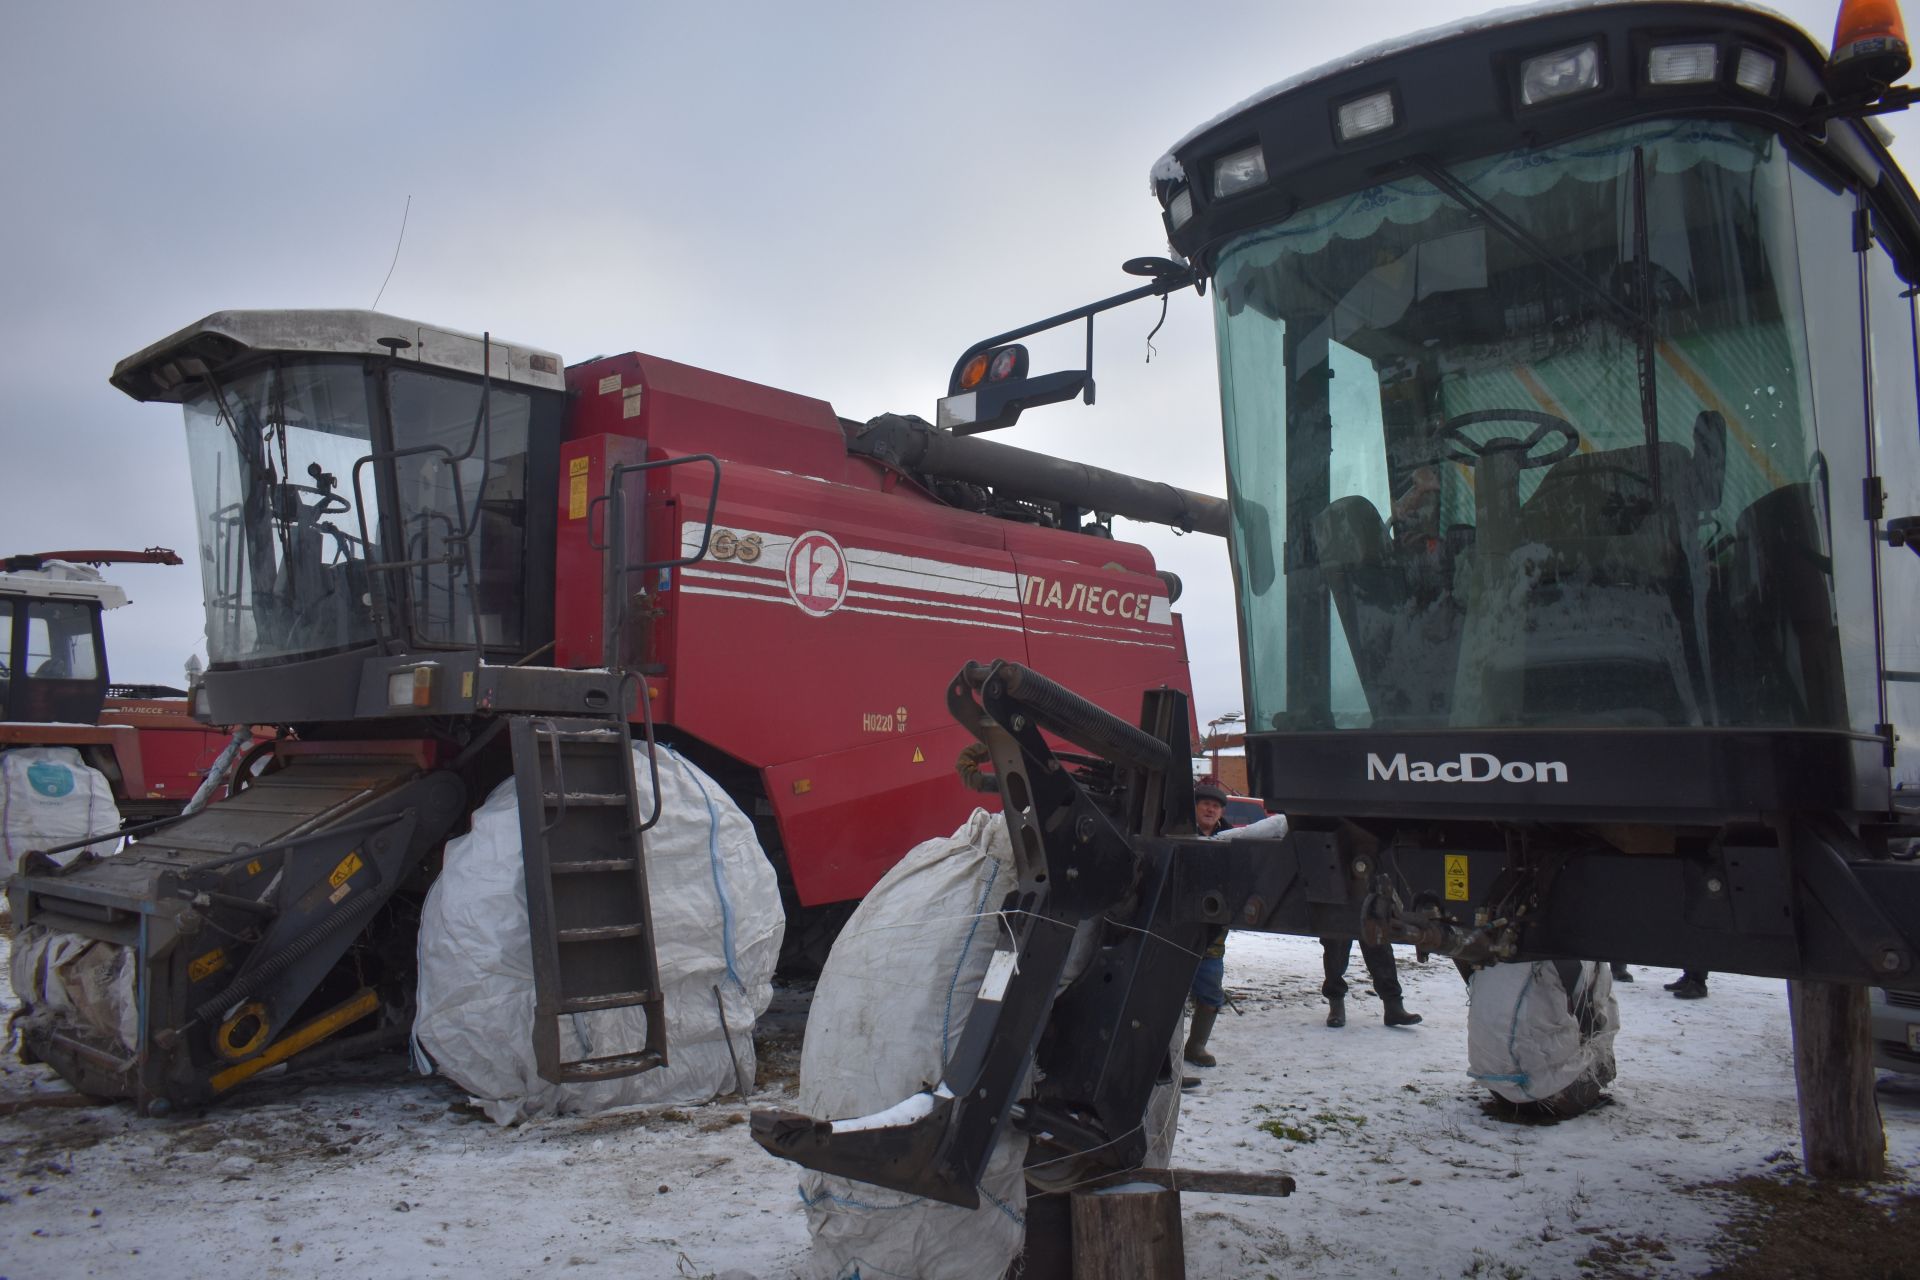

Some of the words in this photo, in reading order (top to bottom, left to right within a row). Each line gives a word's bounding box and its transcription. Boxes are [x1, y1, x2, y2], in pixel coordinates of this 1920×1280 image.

[710, 528, 763, 564] GS
[795, 542, 840, 600] 12
[1023, 575, 1151, 621] ПАЛЕССЕ
[120, 706, 164, 714] ПАЛЕССЕ
[1367, 753, 1568, 782] MacDon
